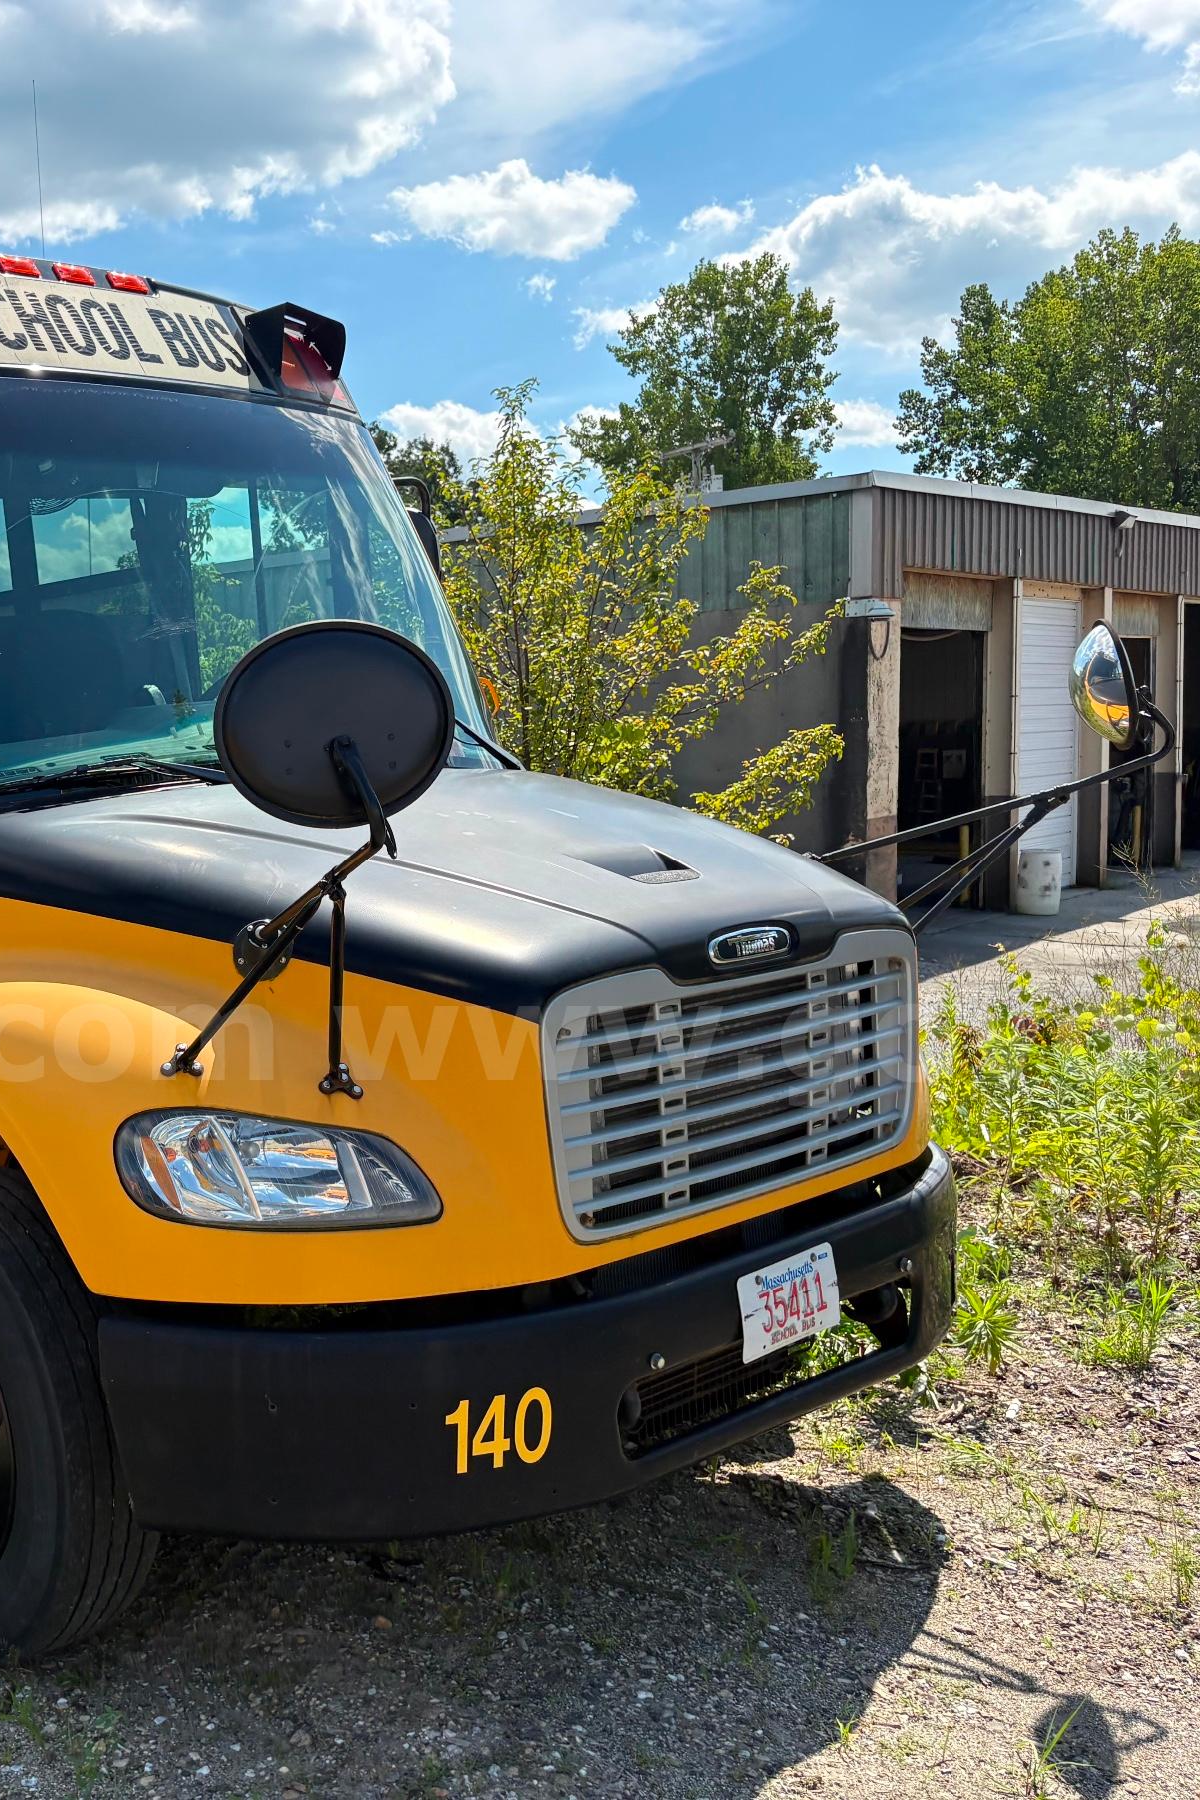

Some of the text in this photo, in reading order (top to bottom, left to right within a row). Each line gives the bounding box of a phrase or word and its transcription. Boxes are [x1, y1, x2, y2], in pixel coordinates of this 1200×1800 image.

[148, 304, 251, 377] BUS
[758, 1269, 827, 1333] 35411
[760, 1260, 814, 1292] Massachusetts
[770, 1317, 816, 1345] SCHOOL BUS
[445, 1386, 552, 1475] 140
